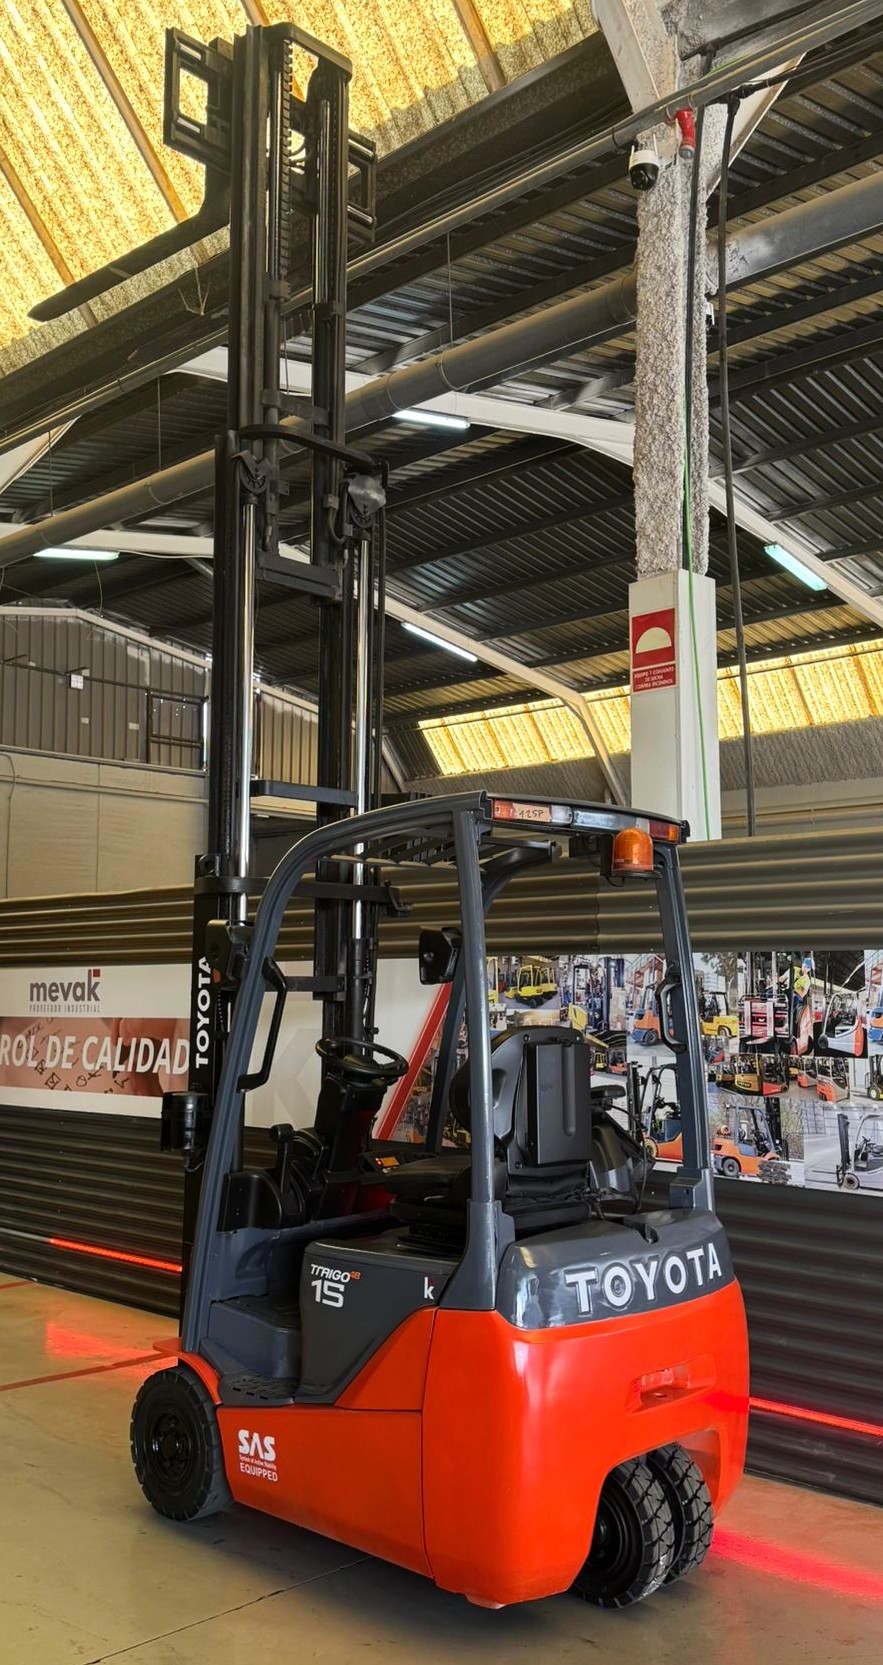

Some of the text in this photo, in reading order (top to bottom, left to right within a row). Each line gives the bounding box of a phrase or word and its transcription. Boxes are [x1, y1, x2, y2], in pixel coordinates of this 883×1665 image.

[30, 969, 100, 1002] mevak
[64, 1004, 100, 1013] INDUSTRIAL
[195, 956, 212, 1069] TOYOTA
[45, 1035, 77, 1069] DE
[81, 1036, 190, 1075] CALIDAD
[311, 1279, 345, 1308] 15
[565, 1242, 723, 1313] TOYOTA
[238, 1429, 276, 1462] SAS
[240, 1462, 278, 1482] EQUIPPED
